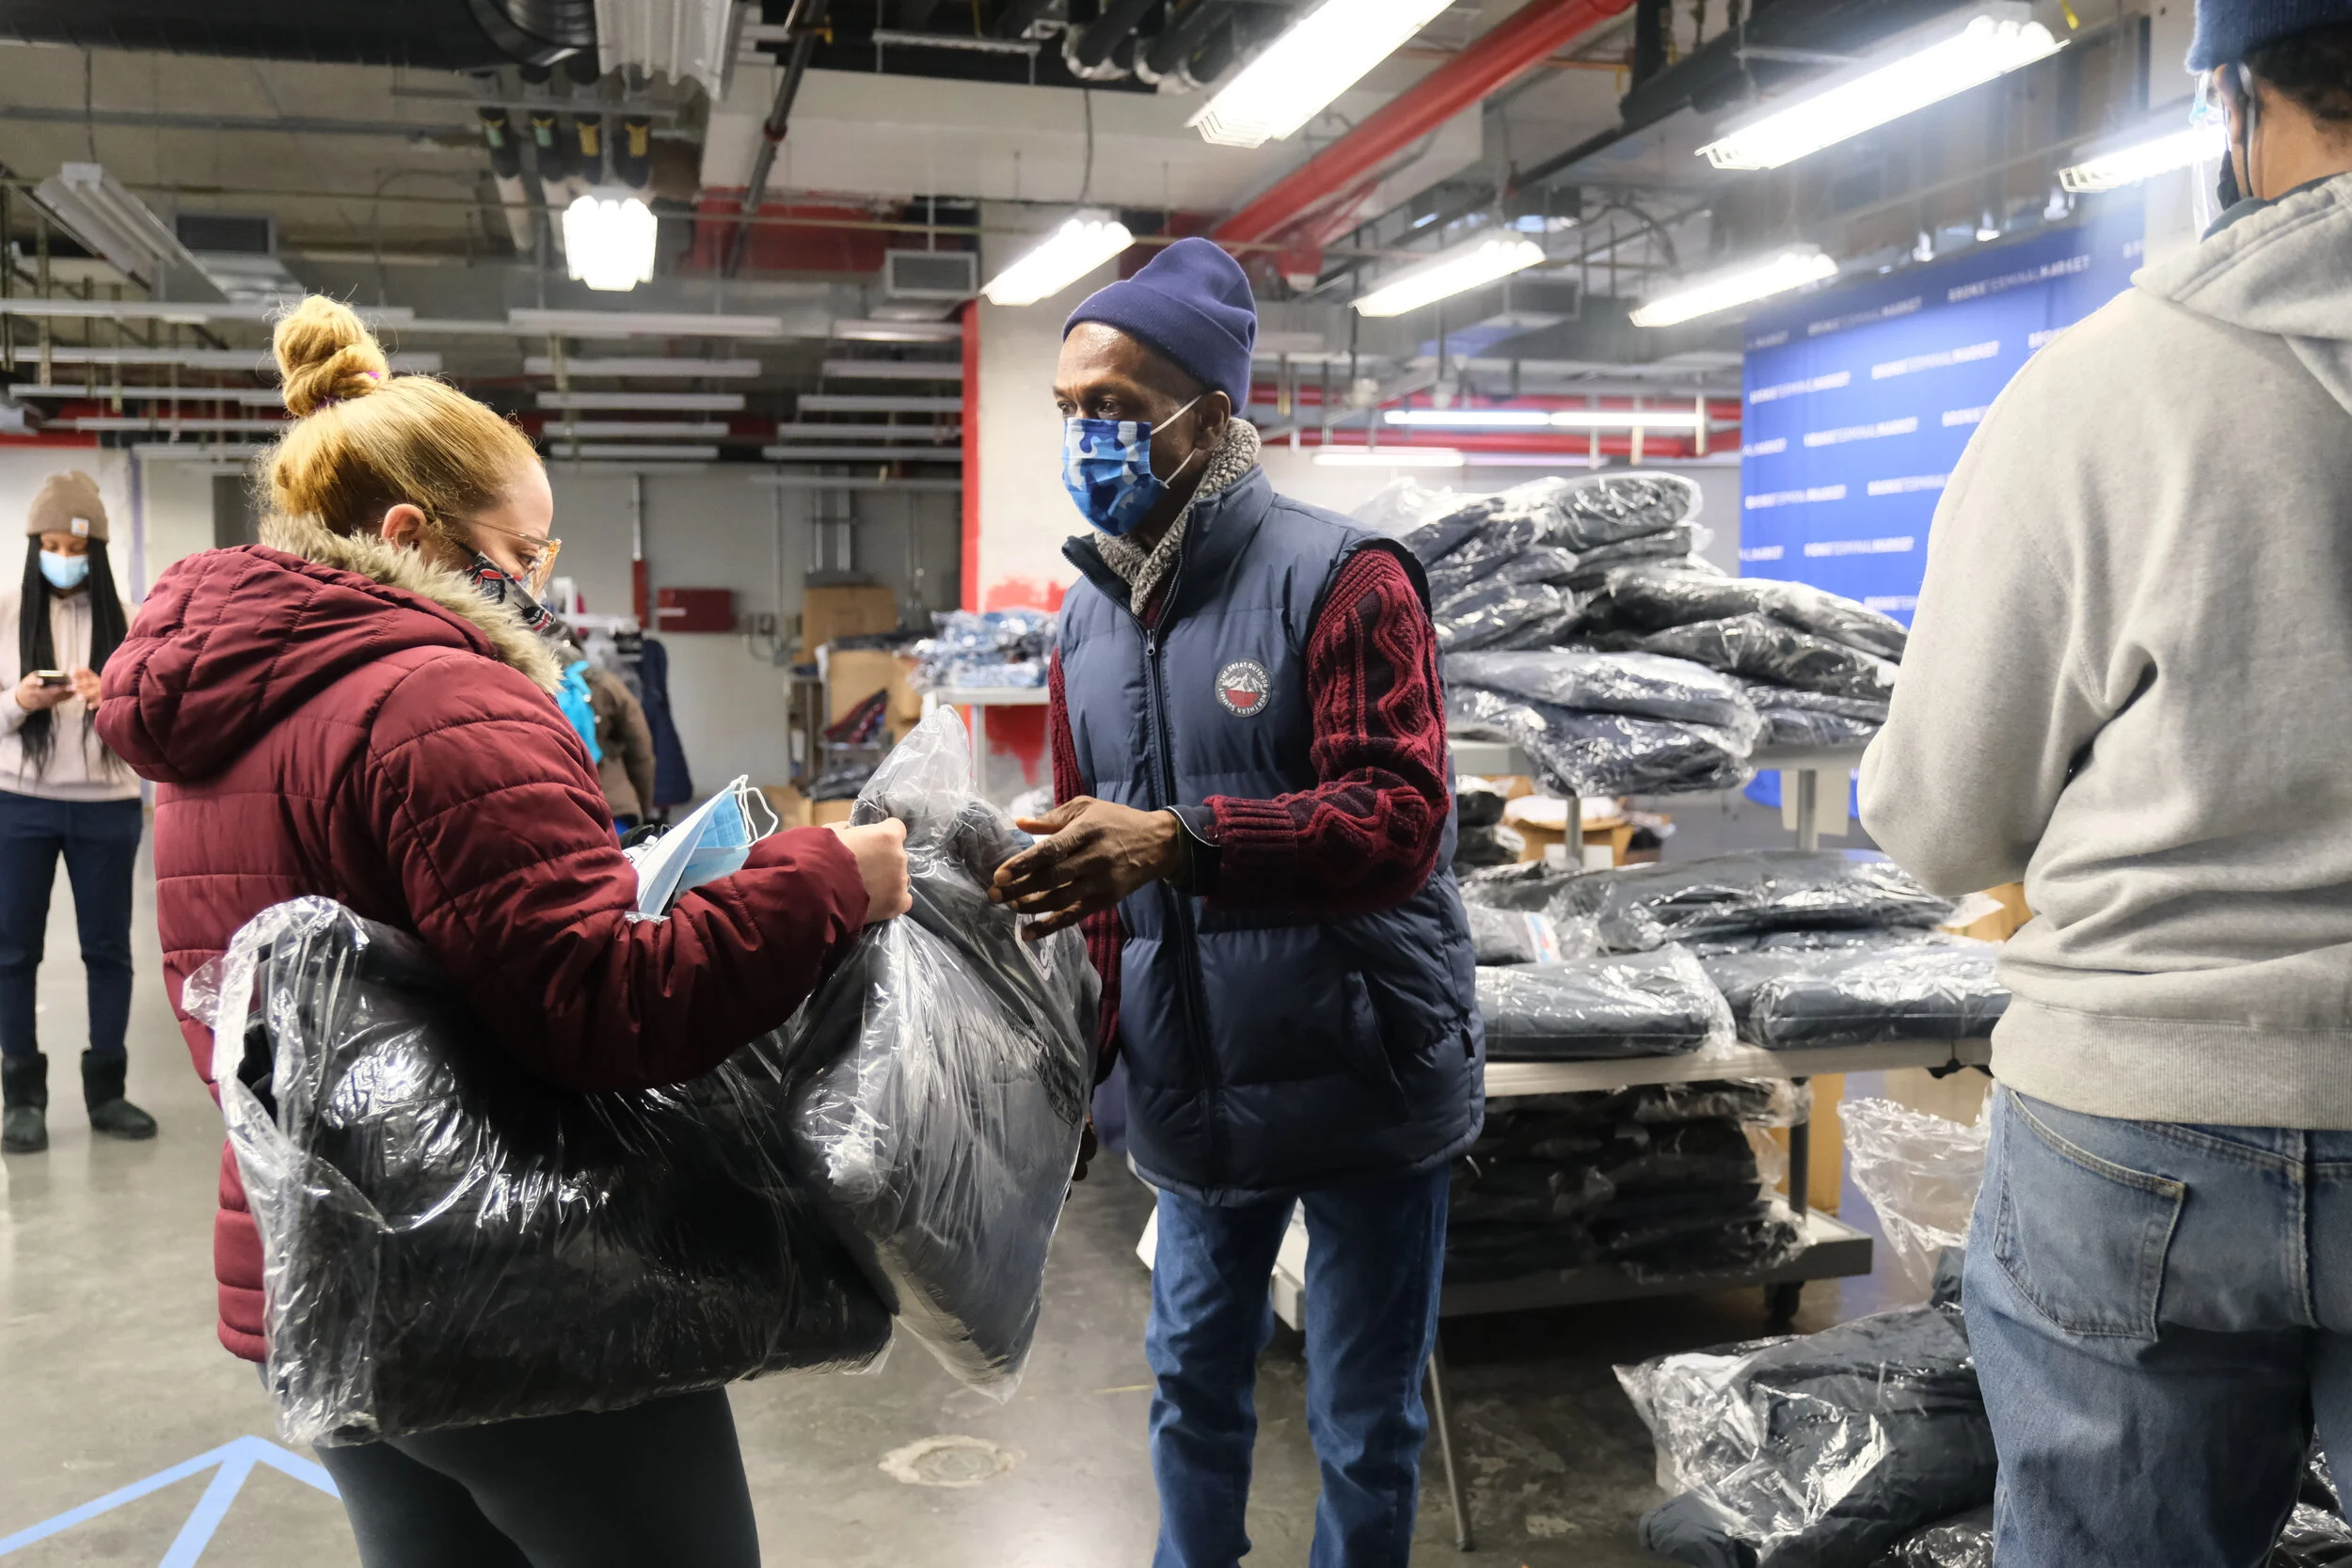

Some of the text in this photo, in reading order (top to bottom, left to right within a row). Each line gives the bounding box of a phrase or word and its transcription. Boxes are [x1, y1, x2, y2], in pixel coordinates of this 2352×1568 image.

[1219, 661, 1269, 688] THE GREAT OUTDOOR
[1218, 688, 1267, 715] NORTHERN SUMMIT
